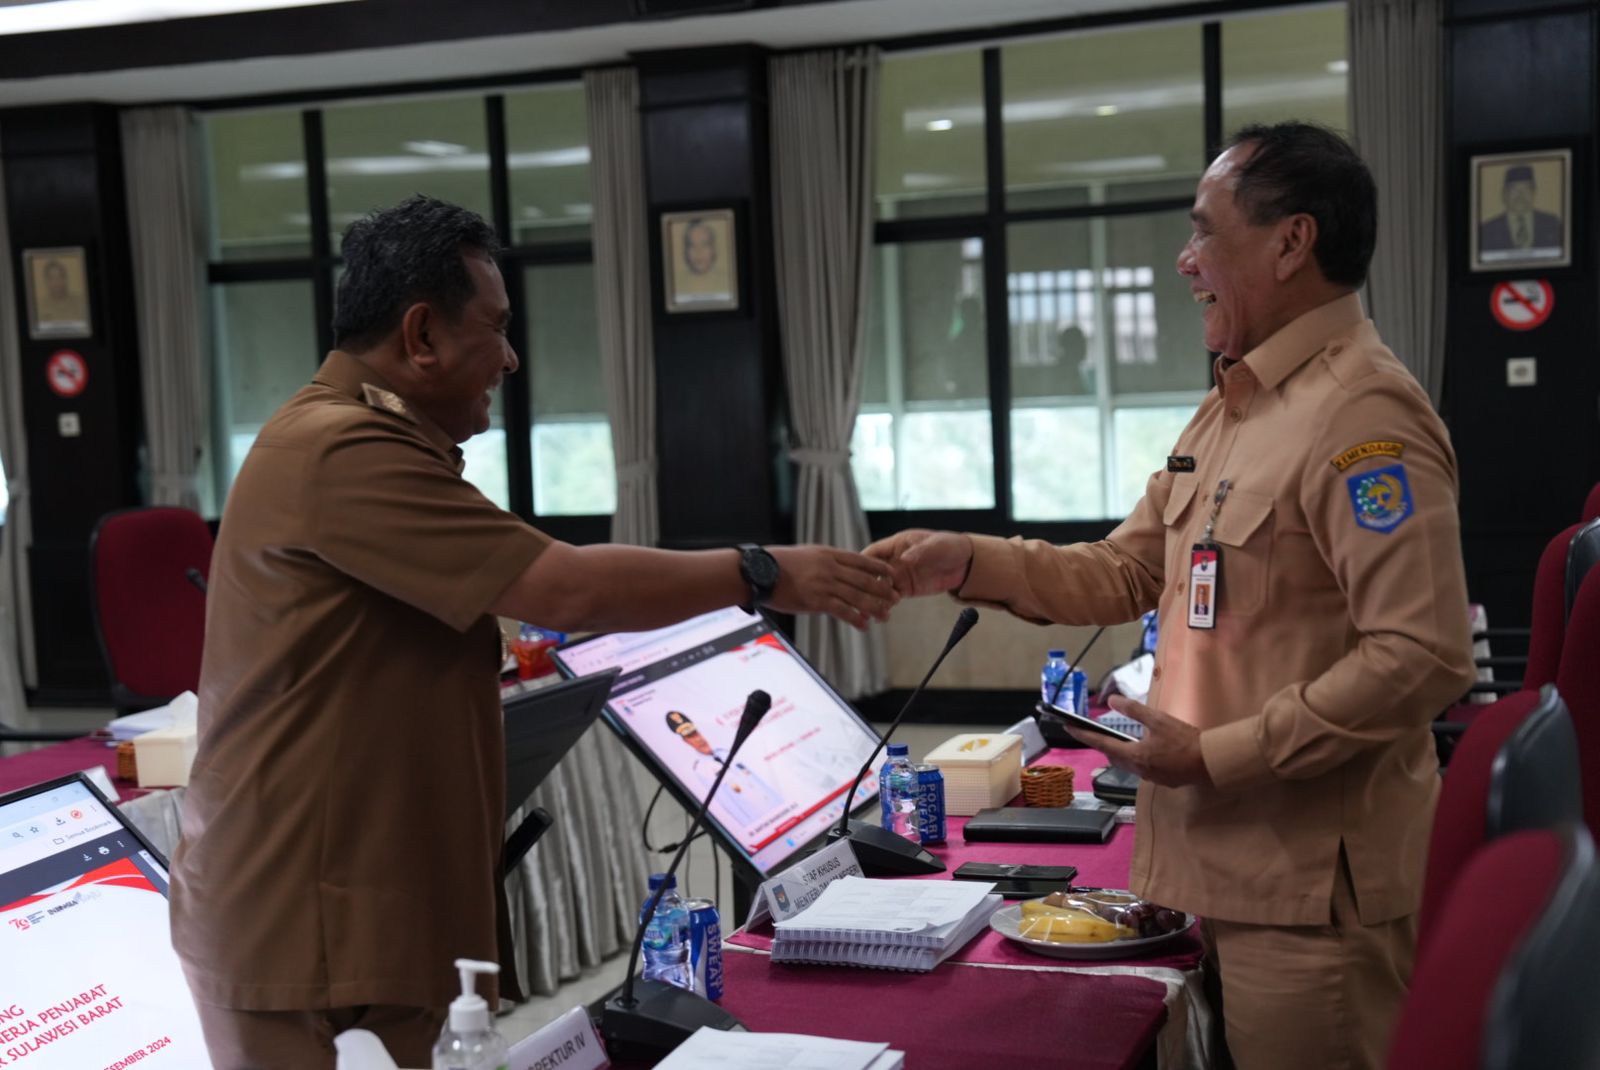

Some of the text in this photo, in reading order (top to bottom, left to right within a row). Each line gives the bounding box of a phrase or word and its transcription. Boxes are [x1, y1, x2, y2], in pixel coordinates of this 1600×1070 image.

[918, 784, 928, 834] SWEAT
[926, 783, 938, 839] POCARI
[802, 856, 841, 886] STAF KHUSUS
[707, 924, 721, 988] SWEAT
[37, 983, 107, 1024] PENJABAT
[7, 996, 123, 1061] SULAWESI BARAT
[146, 1036, 172, 1054] 2024
[574, 1031, 585, 1050] IV
